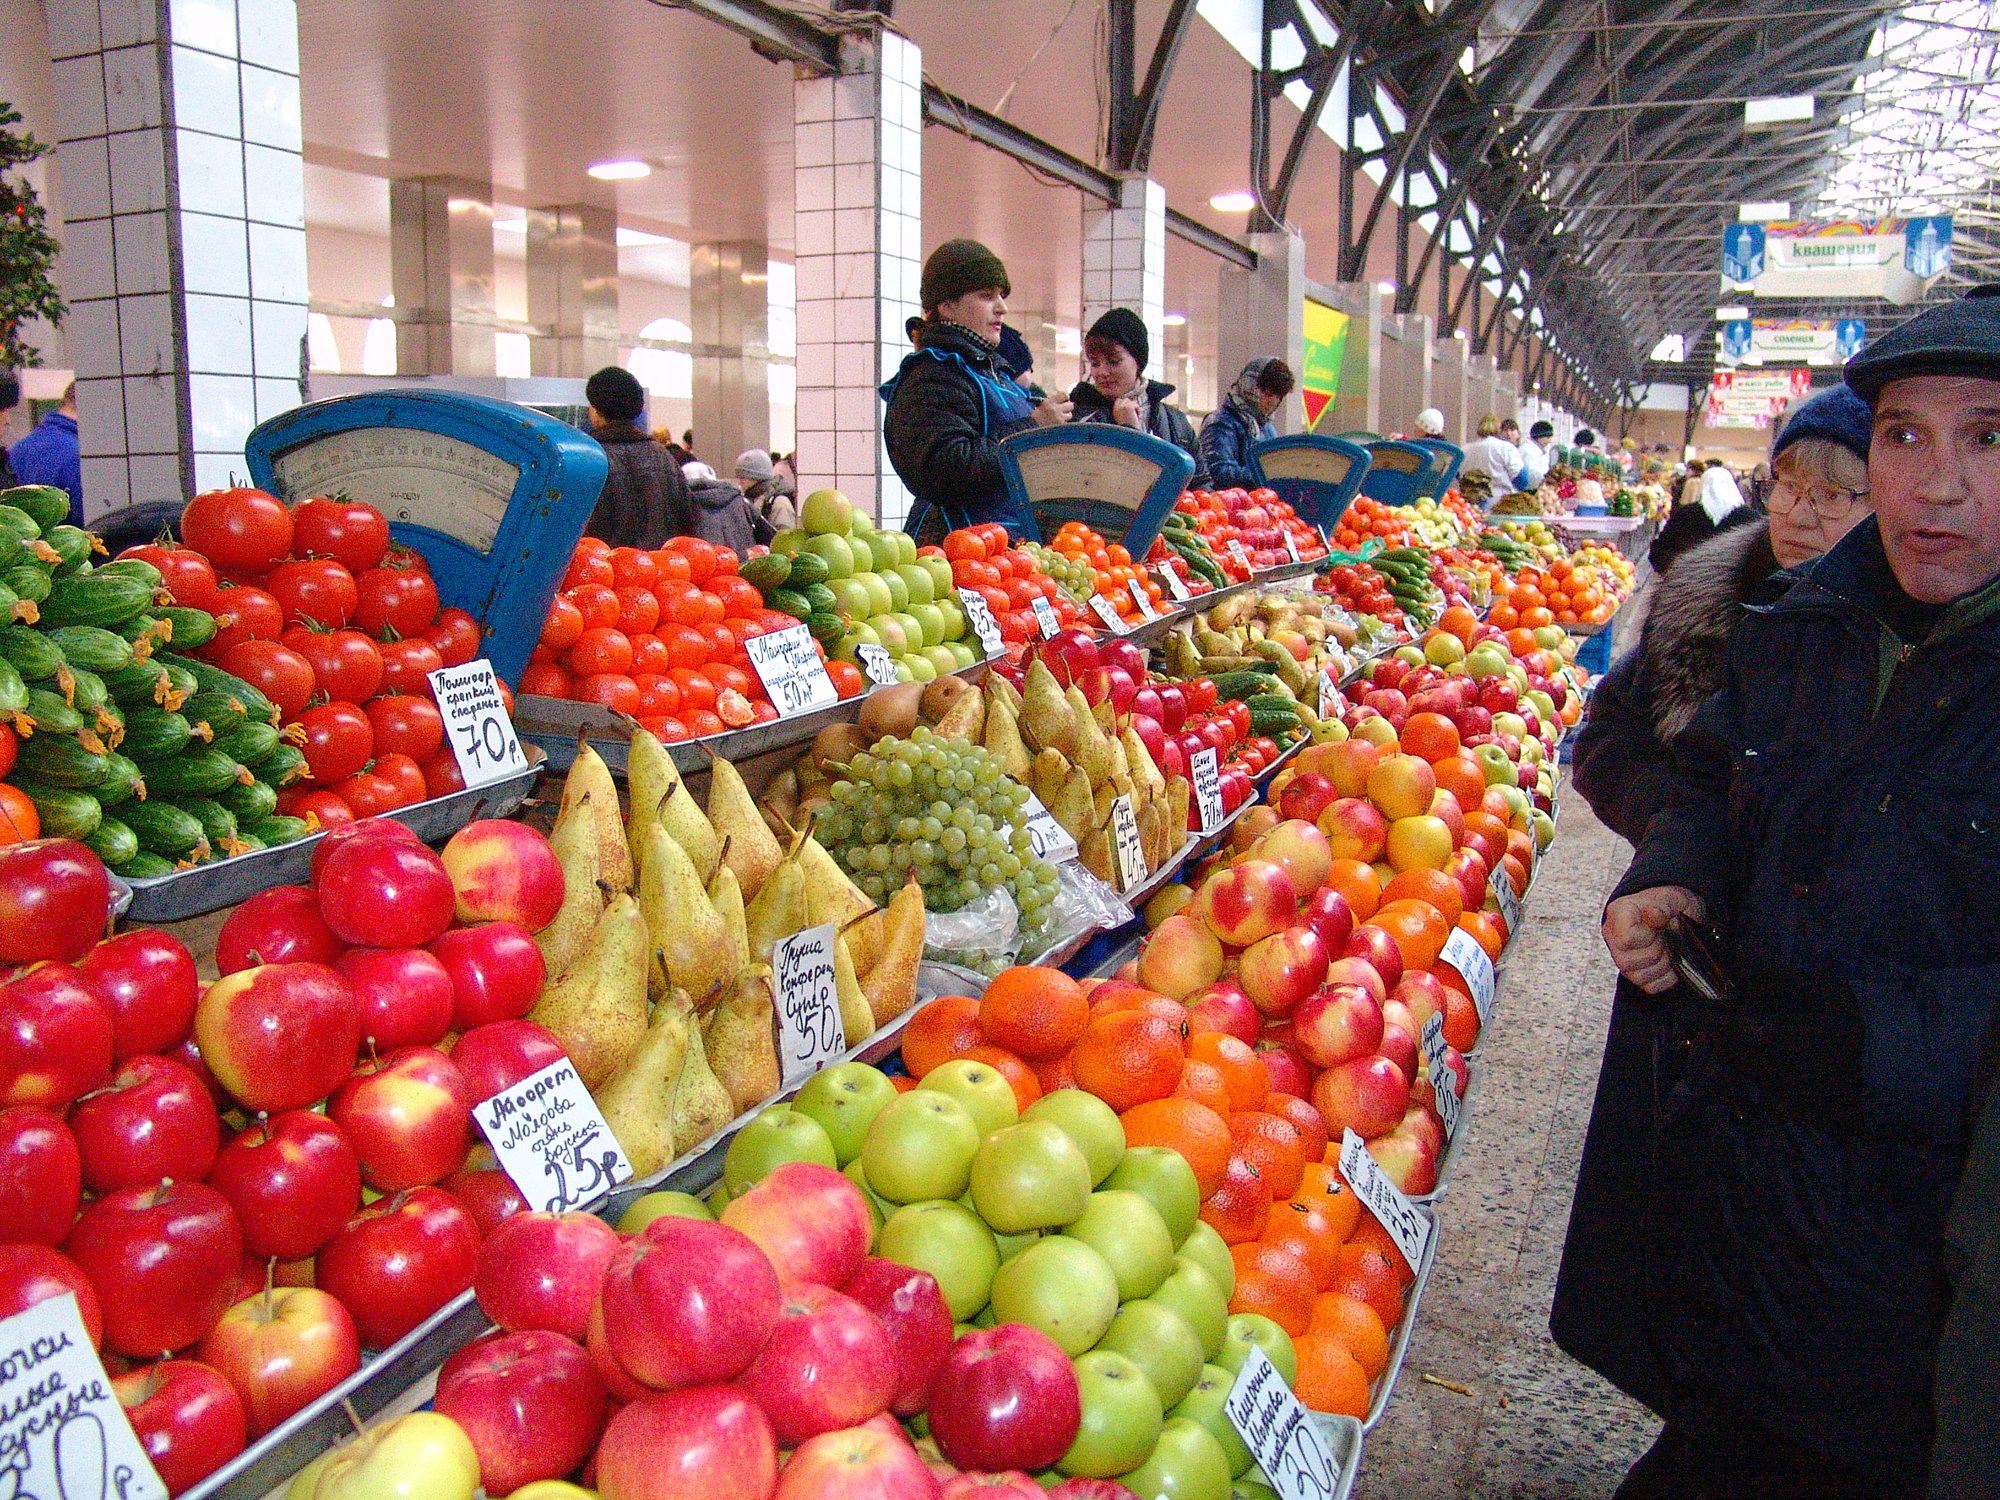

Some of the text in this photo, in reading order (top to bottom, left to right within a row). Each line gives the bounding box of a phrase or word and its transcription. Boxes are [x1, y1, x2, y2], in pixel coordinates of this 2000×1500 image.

[780, 934, 825, 973] Груша
[786, 986, 829, 1033] Супер
[502, 1096, 576, 1150] Молдова
